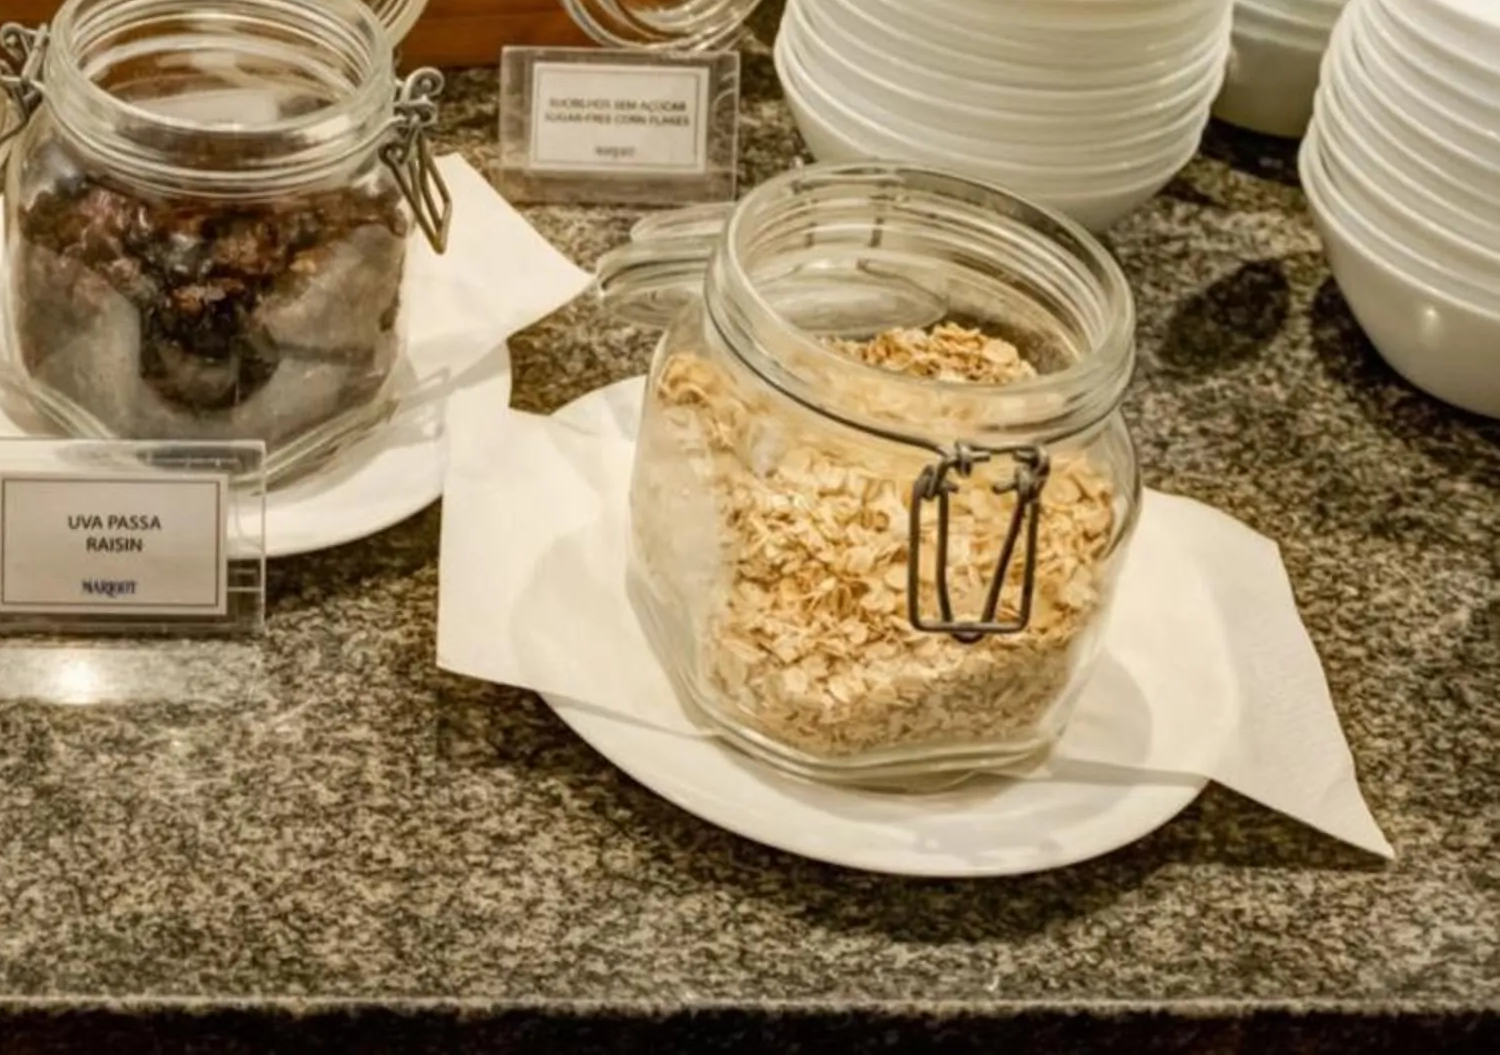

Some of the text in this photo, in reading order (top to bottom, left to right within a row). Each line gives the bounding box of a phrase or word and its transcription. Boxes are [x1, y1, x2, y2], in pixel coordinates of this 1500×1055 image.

[67, 514, 162, 531] UVA PASSA
[85, 535, 143, 554] RAISIN
